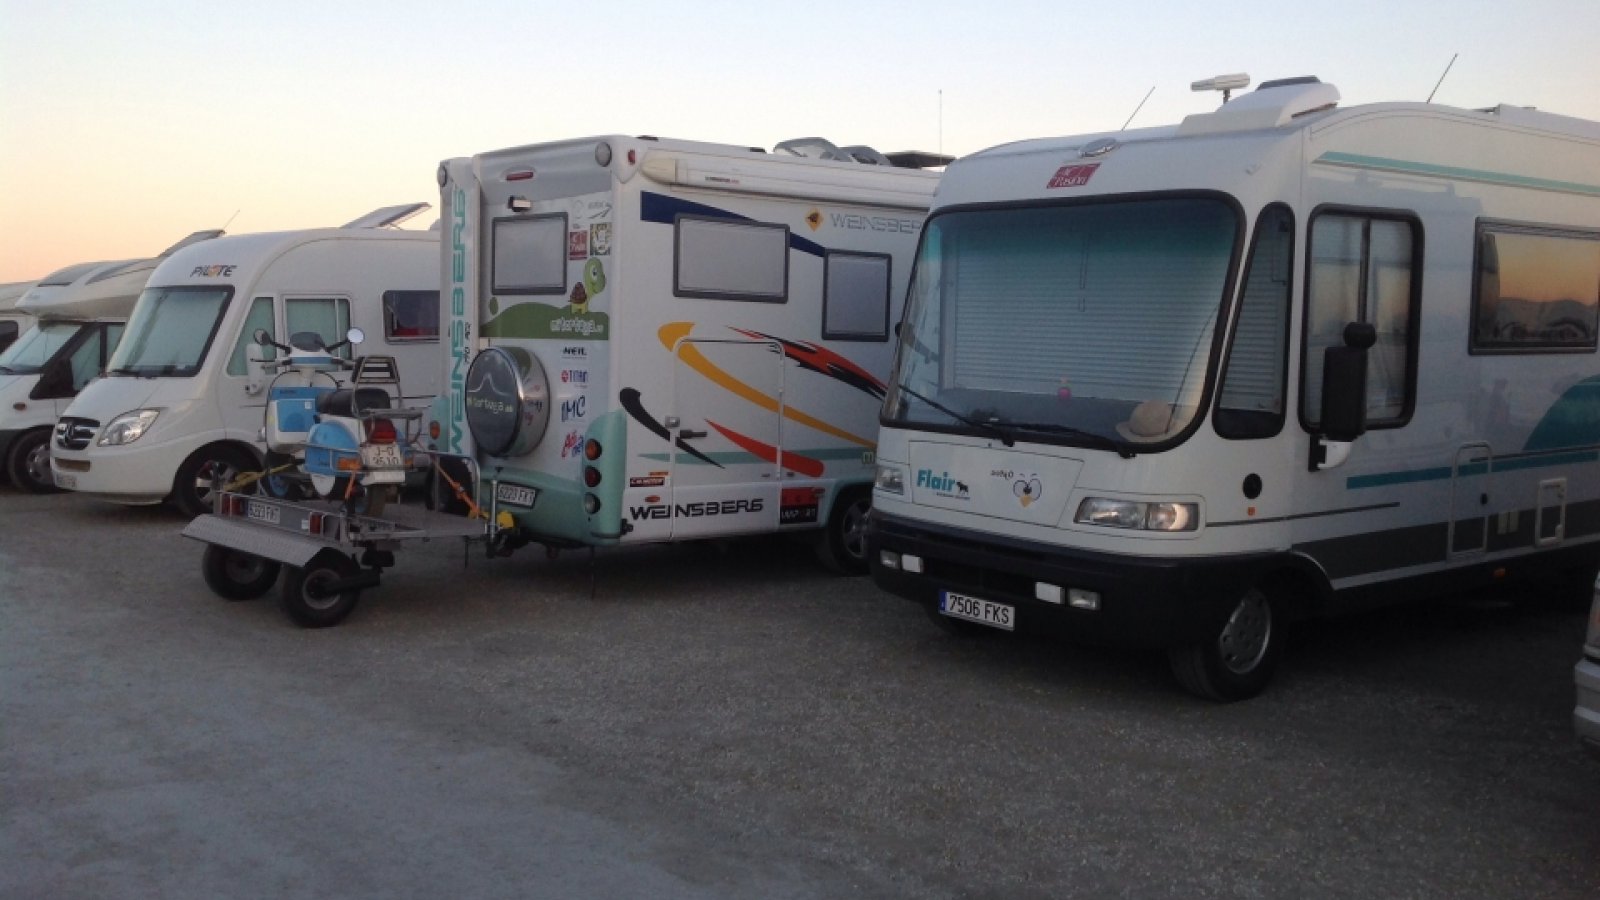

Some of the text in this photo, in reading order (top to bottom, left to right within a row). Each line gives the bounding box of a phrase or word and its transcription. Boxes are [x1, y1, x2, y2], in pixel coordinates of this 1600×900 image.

[190, 264, 237, 278] PILOTE
[450, 188, 466, 455] WEINSBERG
[916, 468, 956, 492] Flair
[630, 498, 764, 520] WEINSBERG
[949, 594, 1010, 625] 7506 FKS
